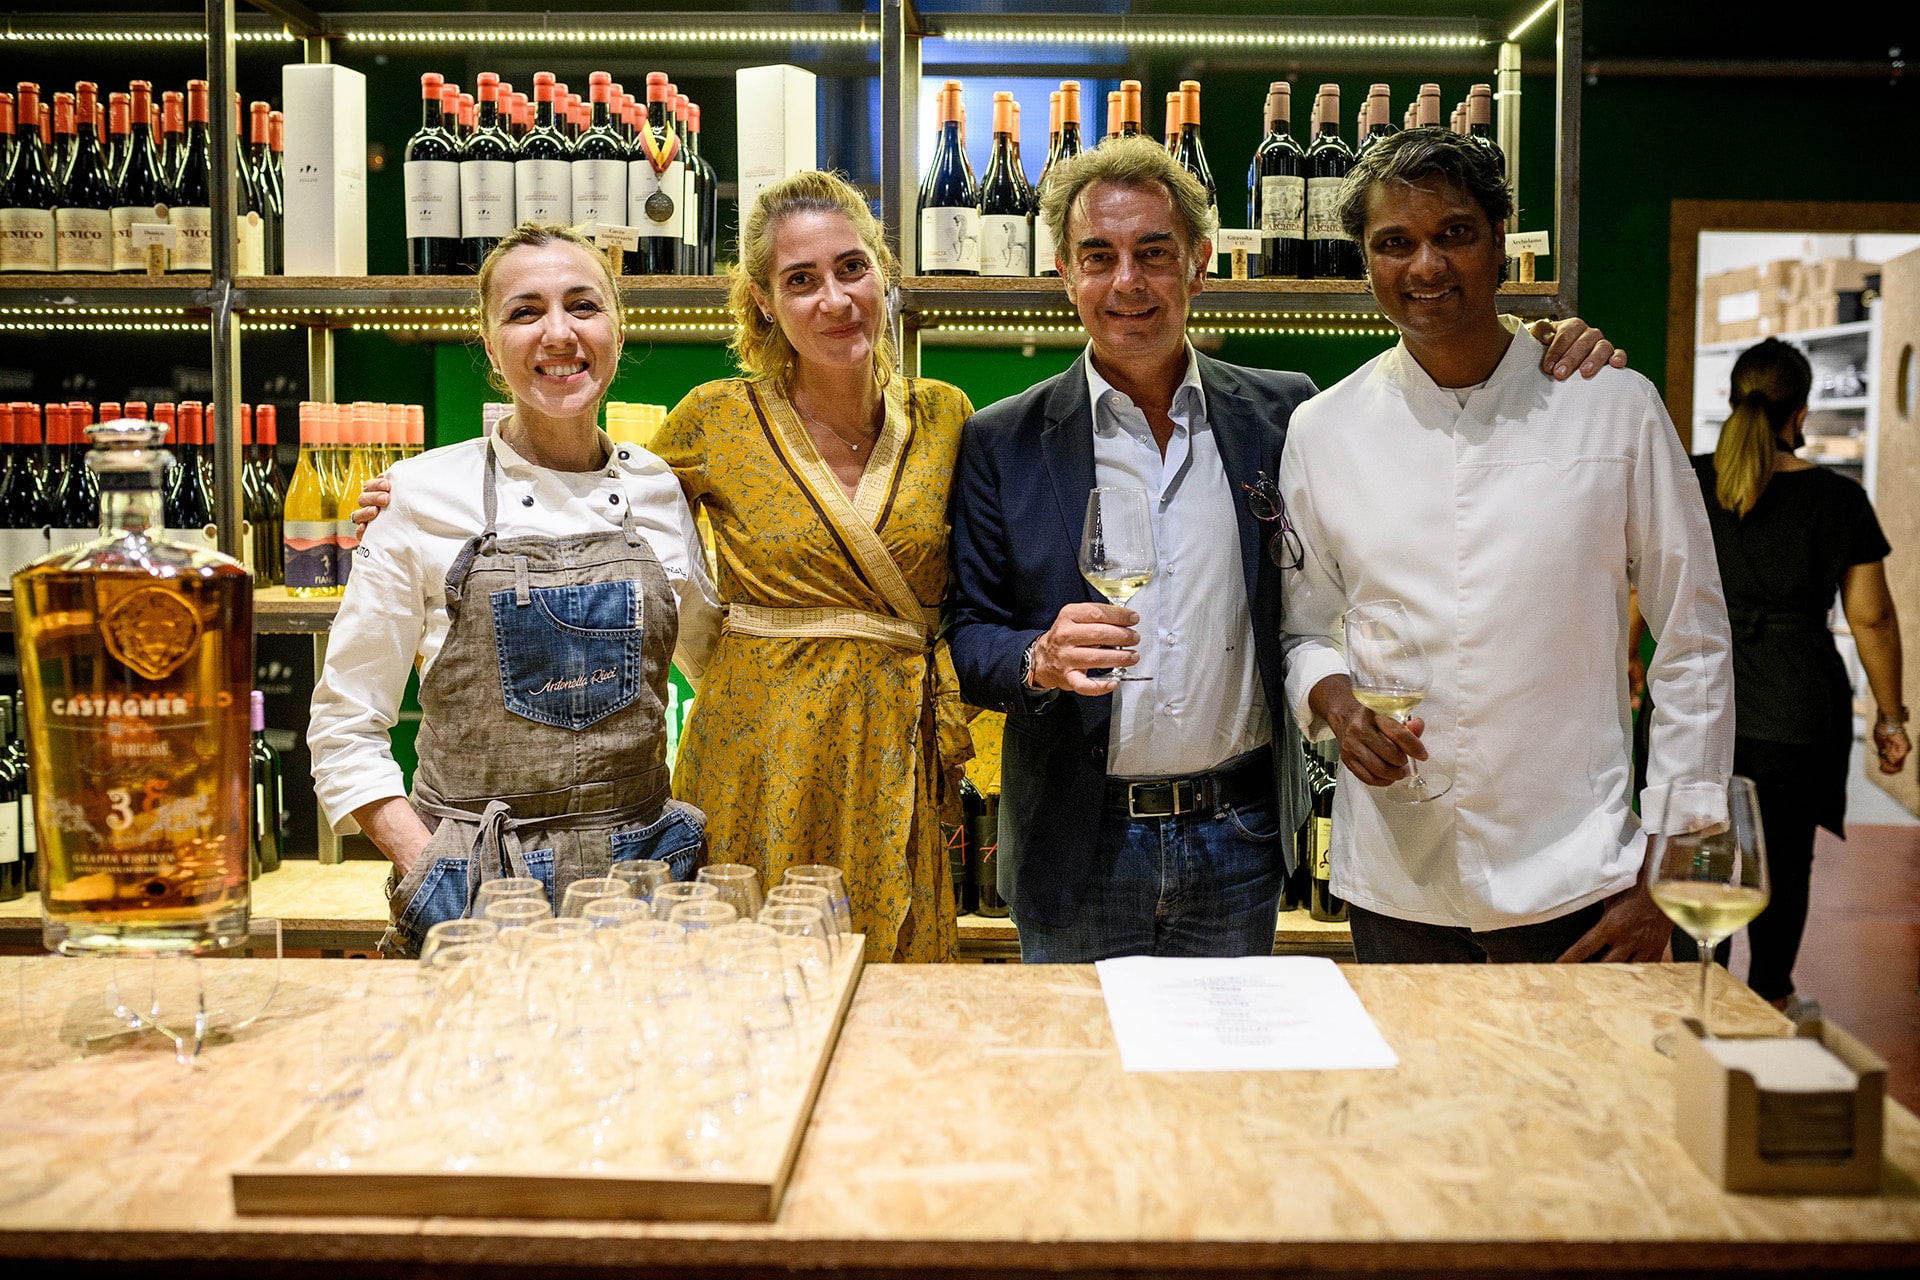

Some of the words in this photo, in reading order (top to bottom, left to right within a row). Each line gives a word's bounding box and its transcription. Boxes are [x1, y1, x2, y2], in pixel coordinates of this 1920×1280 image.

[0, 230, 44, 239] UNICO
[529, 675, 588, 696] Antonella
[591, 666, 618, 685] Ricci
[51, 698, 188, 717] CASTAGNER
[106, 788, 134, 831] 3
